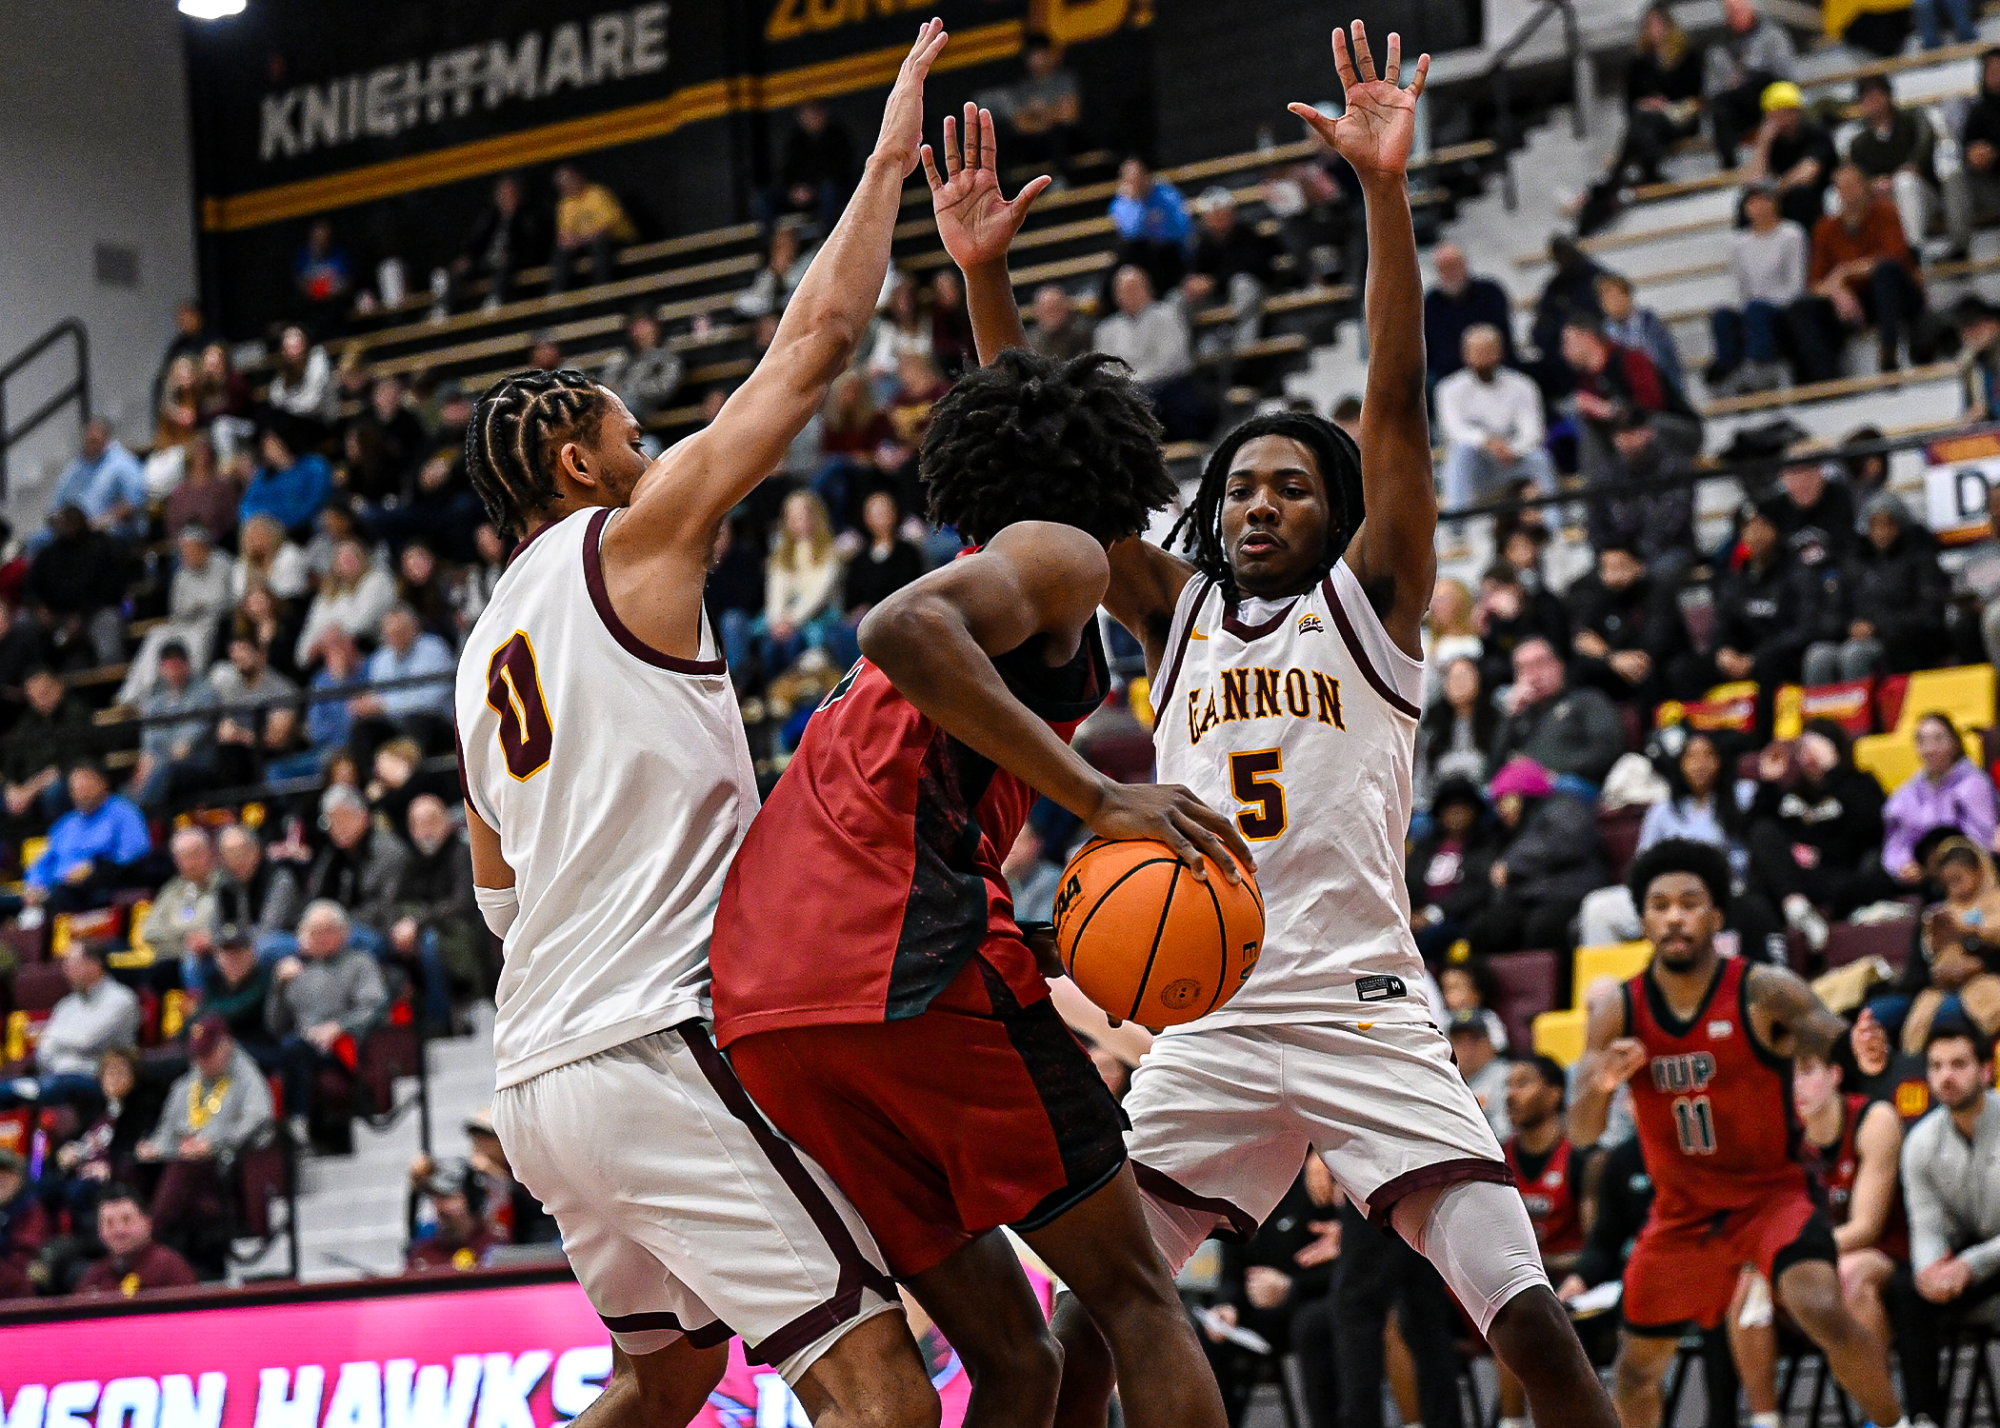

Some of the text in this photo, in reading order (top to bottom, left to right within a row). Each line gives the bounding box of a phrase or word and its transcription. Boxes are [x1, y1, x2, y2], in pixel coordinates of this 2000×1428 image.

[486, 629, 553, 782] 0
[1188, 666, 1346, 745] GANNON
[1228, 747, 1288, 842] 5
[1391, 980, 1401, 990] M
[1672, 1095, 1717, 1155] 11
